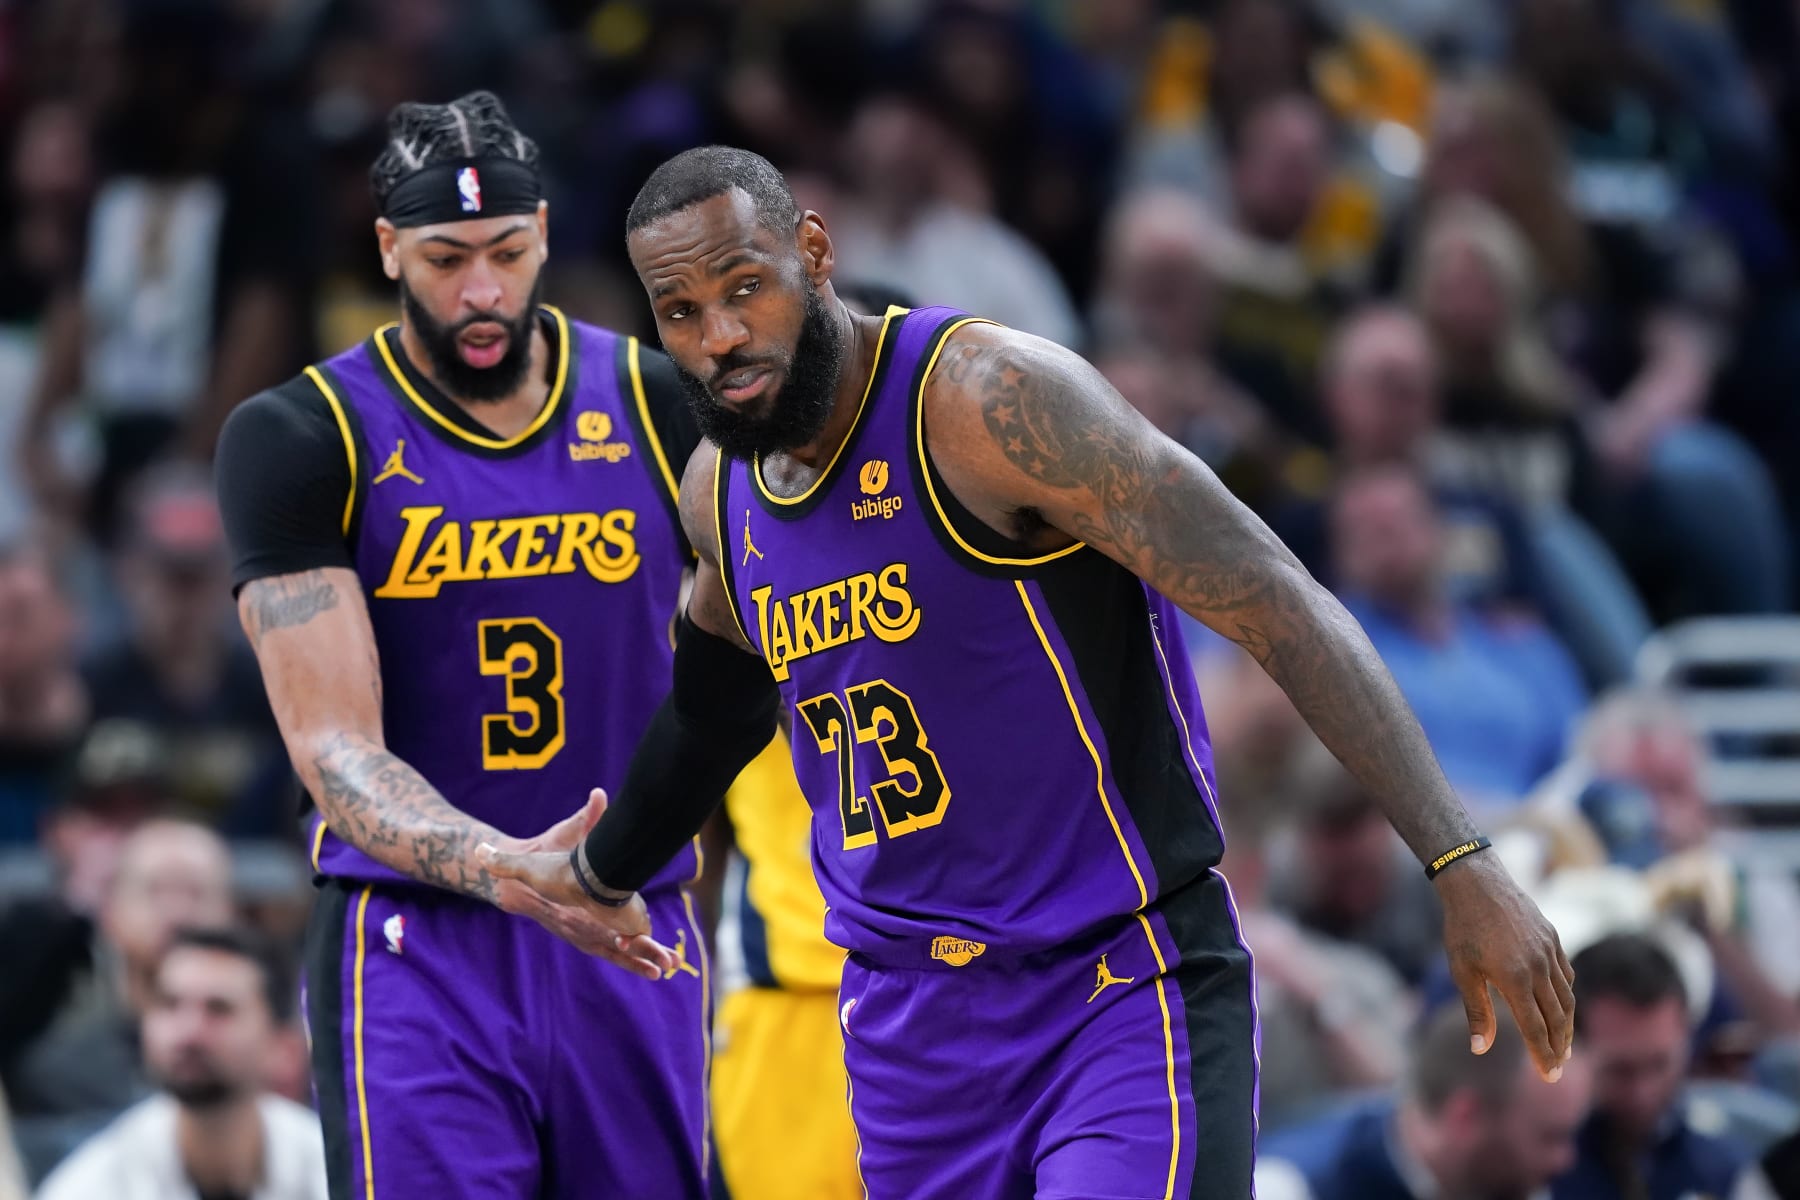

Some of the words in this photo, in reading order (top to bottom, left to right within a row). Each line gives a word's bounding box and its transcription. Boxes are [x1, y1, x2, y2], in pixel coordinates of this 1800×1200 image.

[568, 441, 631, 463] bibigo
[851, 496, 902, 521] bibigo
[374, 506, 641, 598] LAKERS
[751, 563, 922, 682] LAKERS
[477, 616, 566, 770] 3
[795, 678, 952, 851] 23
[1432, 841, 1475, 870] PROMISE
[934, 940, 980, 957] LAKERS
